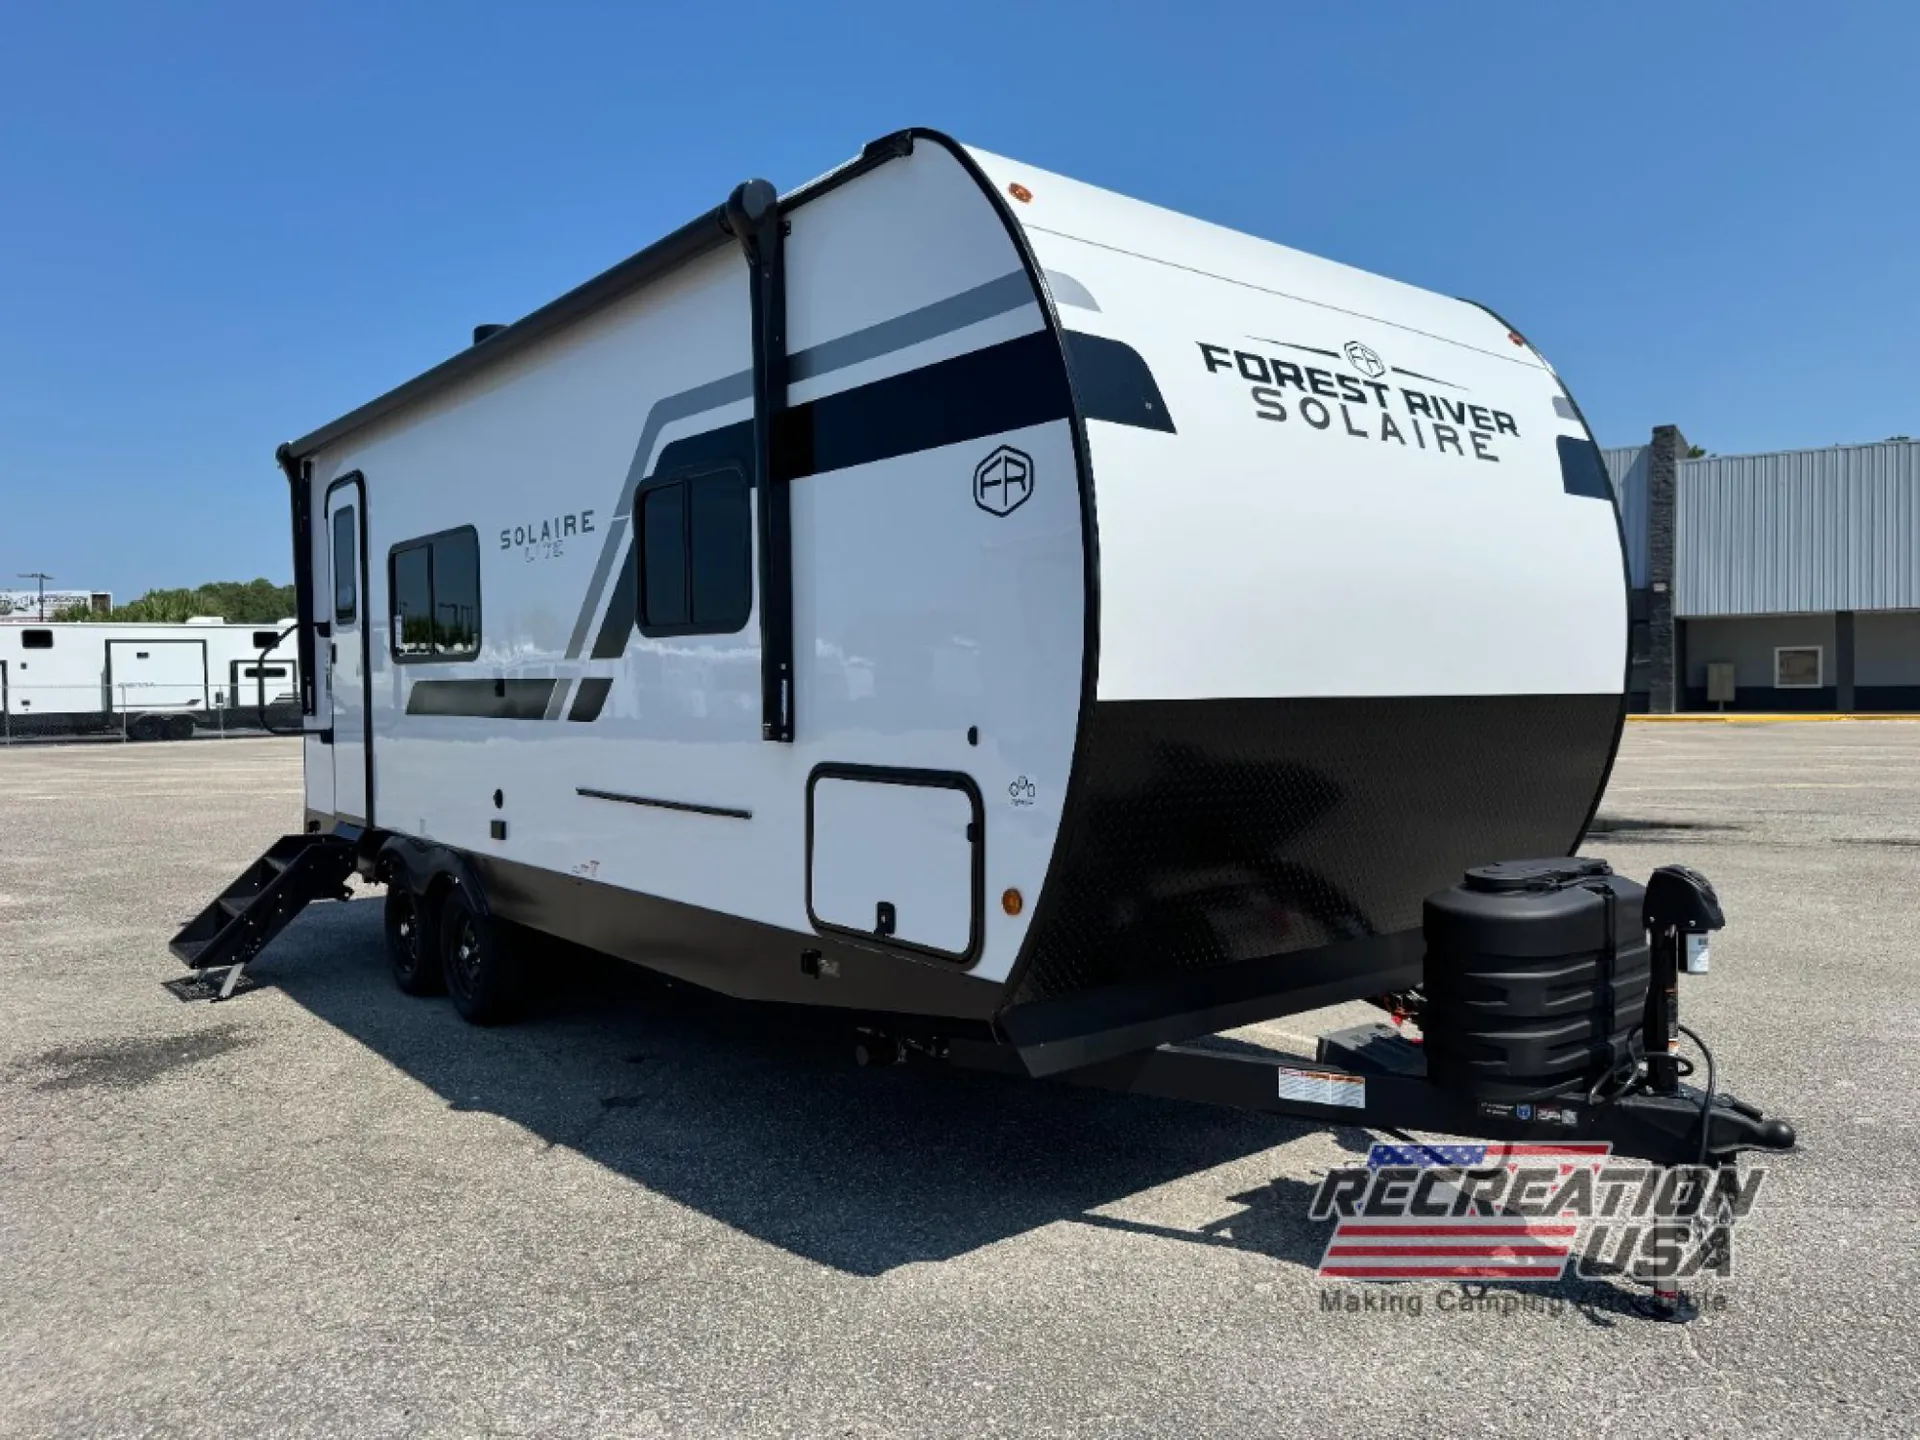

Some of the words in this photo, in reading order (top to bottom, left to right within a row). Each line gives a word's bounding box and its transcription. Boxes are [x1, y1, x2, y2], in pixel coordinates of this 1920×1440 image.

[1195, 341, 1389, 409] FOREST
[1399, 388, 1520, 437] RIVER
[1252, 386, 1499, 462] SOLAIRE
[500, 509, 595, 550] SOLAIRE
